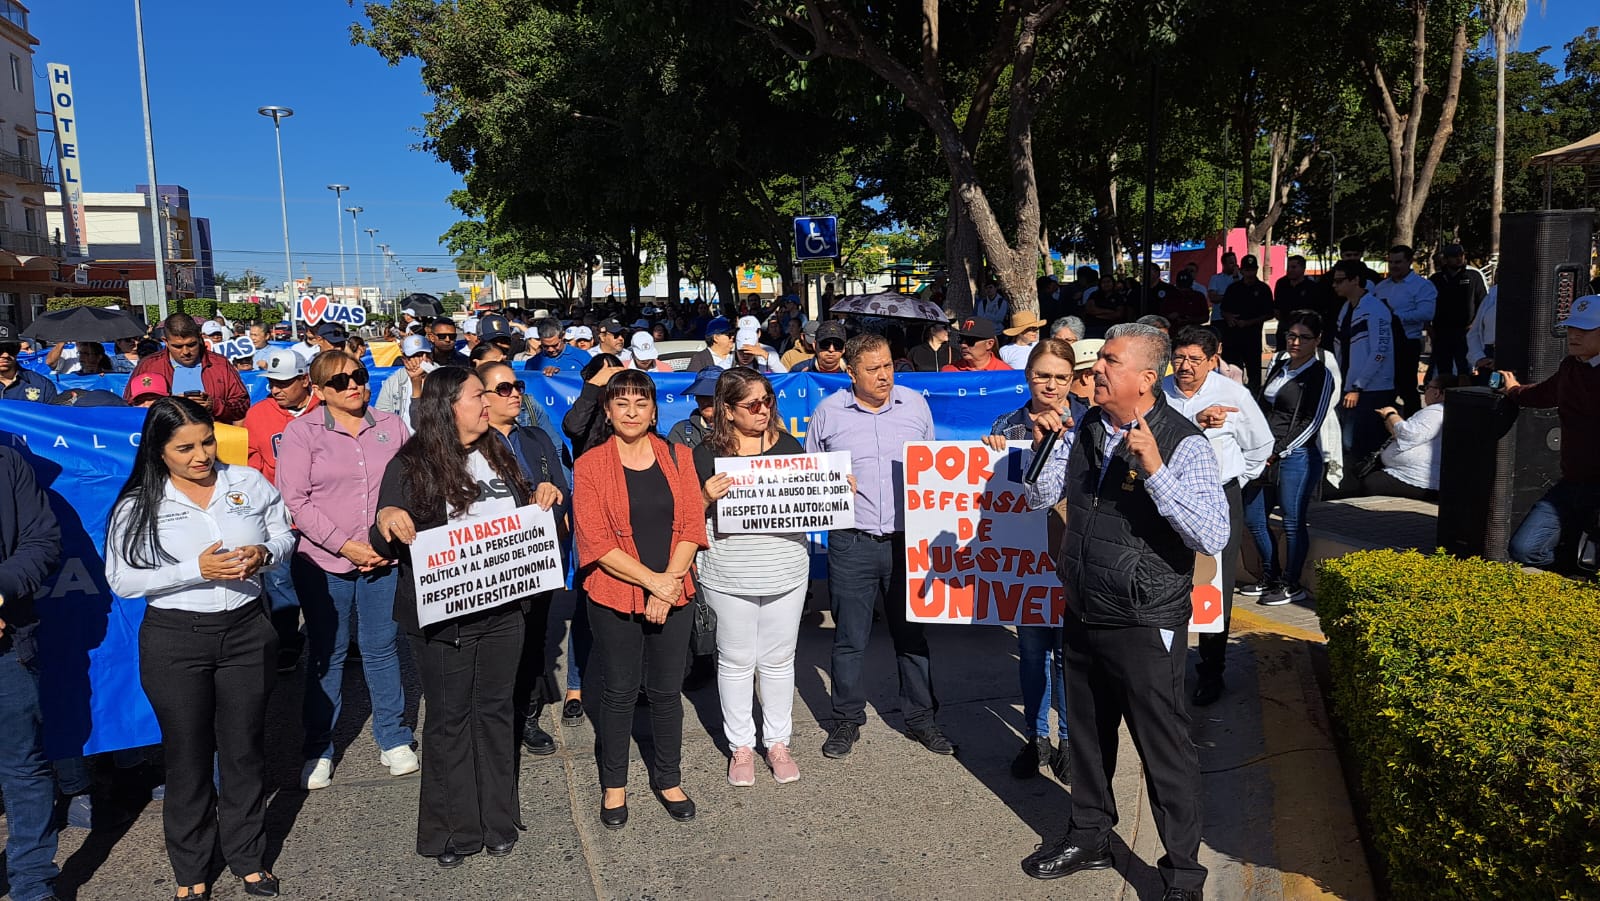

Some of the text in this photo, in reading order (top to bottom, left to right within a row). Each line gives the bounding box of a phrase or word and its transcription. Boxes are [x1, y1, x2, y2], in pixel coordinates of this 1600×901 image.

[54, 69, 78, 183] HOTEL
[323, 305, 365, 324] UAS
[775, 457, 818, 470] BASTA!
[907, 445, 995, 485] POR
[758, 476, 763, 484] A
[759, 488, 764, 496] Y
[767, 488, 776, 496] AL
[779, 486, 804, 496] ABUSO
[807, 486, 821, 495] DEL
[722, 499, 849, 516] ¡RESPETO A LA AUTONOMÍA
[907, 489, 1033, 513] DEFENSA
[449, 514, 521, 547] ¡YA BASTA!
[743, 515, 833, 529] UNIVERSITARIA!
[958, 518, 992, 542] DE
[428, 527, 545, 568] ALTO A LA PERSECUCIÓN
[907, 538, 1057, 577] NUESTRA
[420, 540, 555, 586] POLÍTICA Y AL ABUSO DEL PODER
[422, 558, 556, 605] ¡RESPETO A LA AUTONOMÍA
[445, 576, 540, 614] UNIVERSITARIA!
